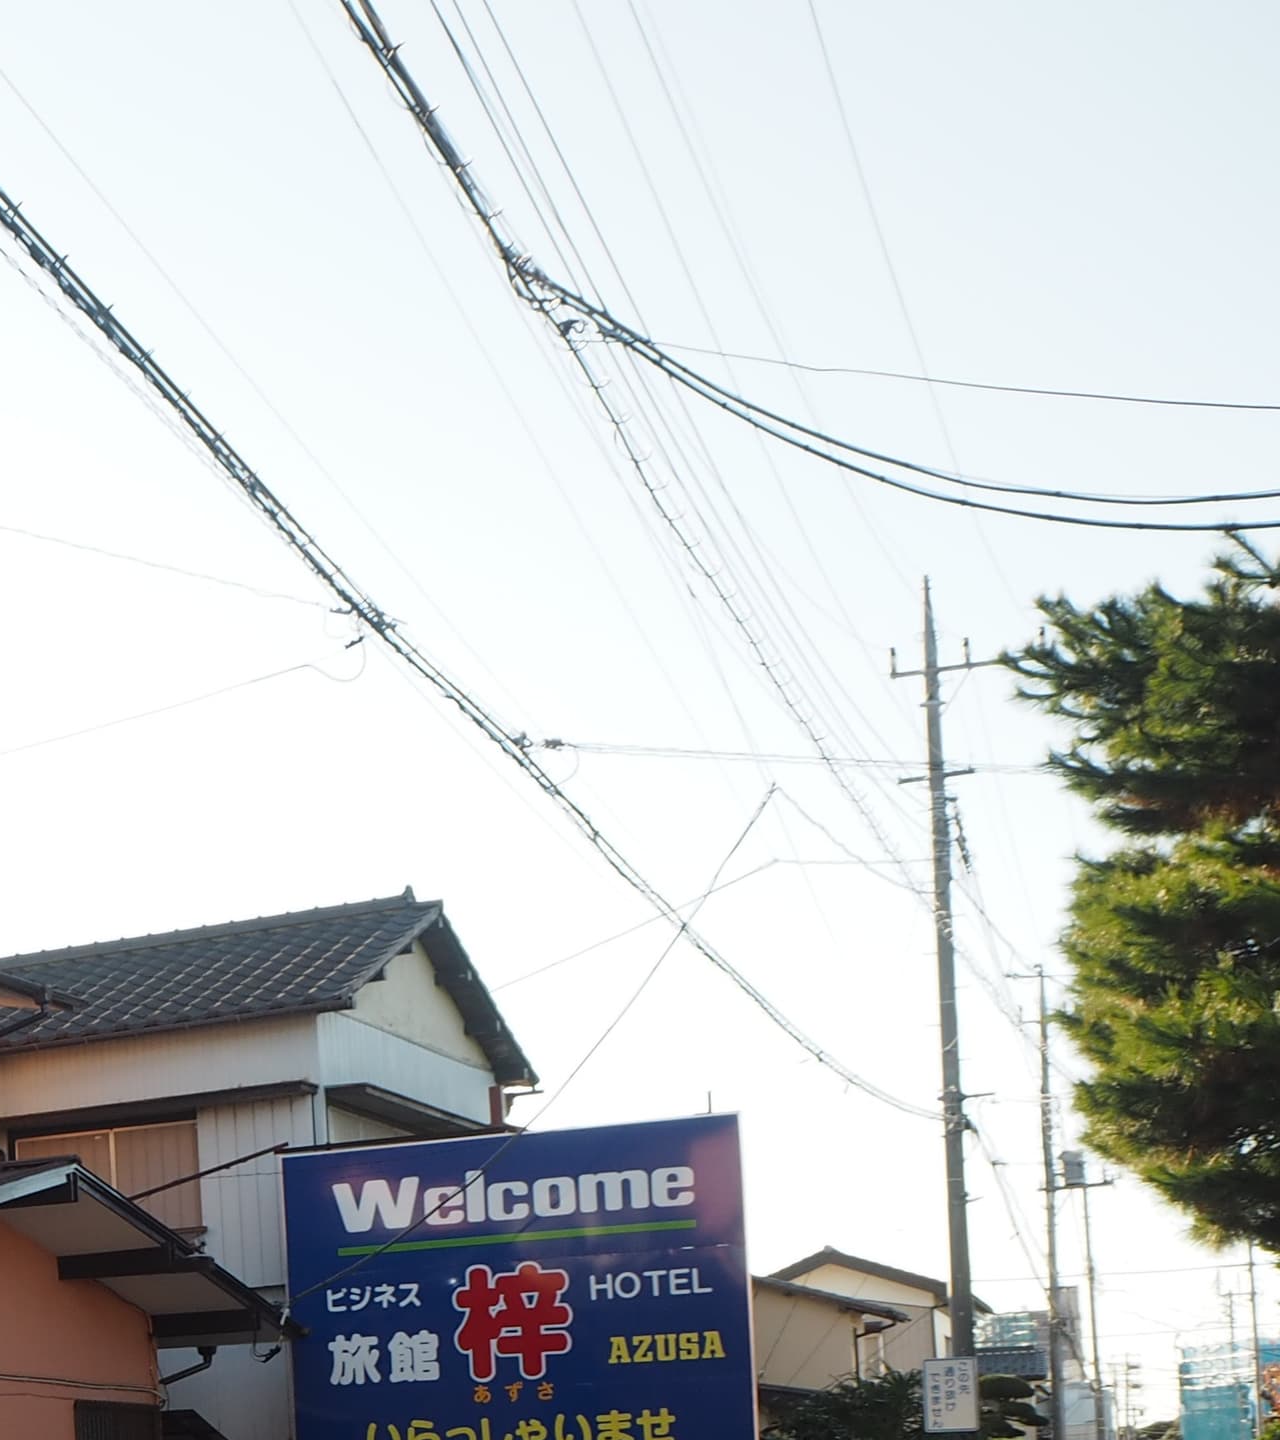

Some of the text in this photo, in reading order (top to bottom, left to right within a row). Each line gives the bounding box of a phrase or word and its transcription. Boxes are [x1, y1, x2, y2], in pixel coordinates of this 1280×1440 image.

[332, 1166, 695, 1234] Welcome
[325, 1283, 422, 1313] ビジネス
[589, 1267, 713, 1301] HOTEL
[452, 1260, 574, 1382] 梓
[328, 1329, 440, 1385] 旅館
[608, 1330, 726, 1365] AZUSA
[473, 1381, 555, 1404] あずさ
